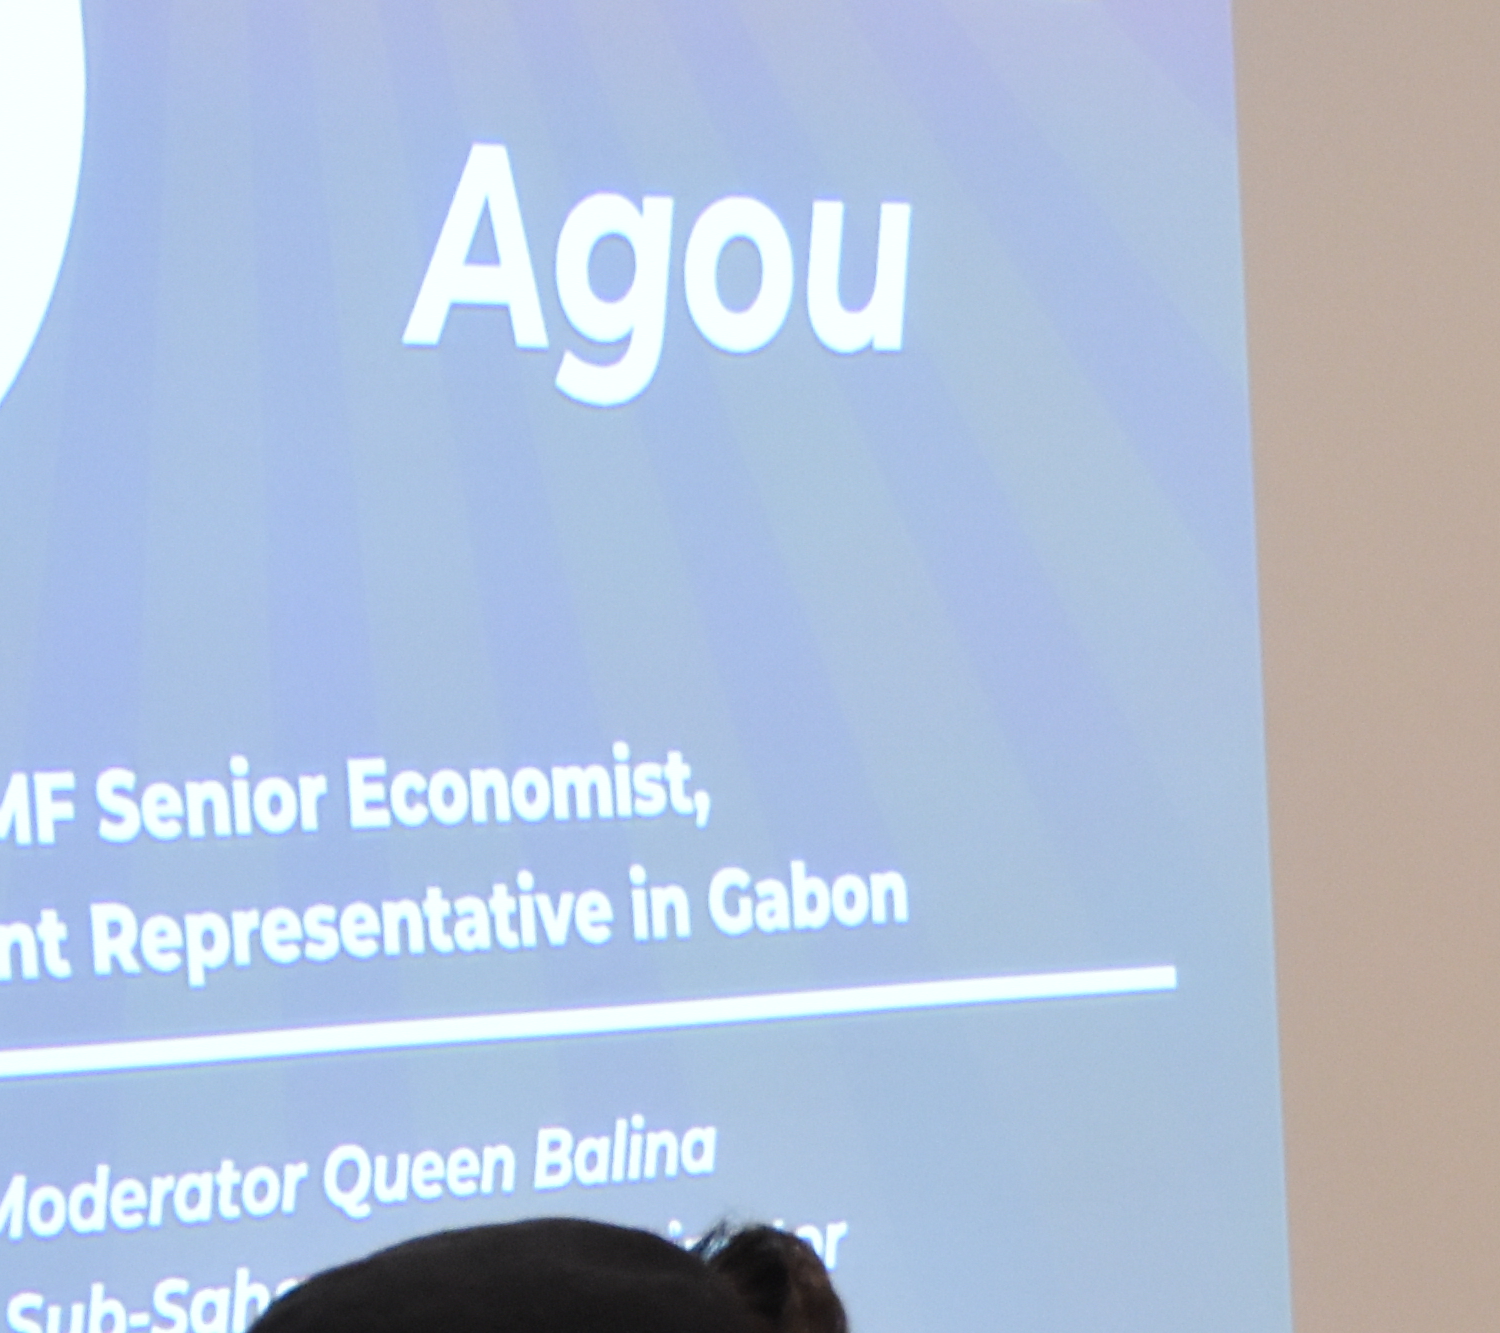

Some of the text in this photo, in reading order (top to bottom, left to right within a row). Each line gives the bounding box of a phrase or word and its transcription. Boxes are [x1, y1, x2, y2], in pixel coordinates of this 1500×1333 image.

[401, 142, 913, 407] Agou
[95, 754, 327, 840] Senior
[346, 739, 712, 827] Economist,
[89, 868, 614, 986] Representative
[628, 862, 691, 939] in
[708, 859, 908, 934] Gabon
[323, 1143, 516, 1218] Queen
[534, 1115, 717, 1188] Balina
